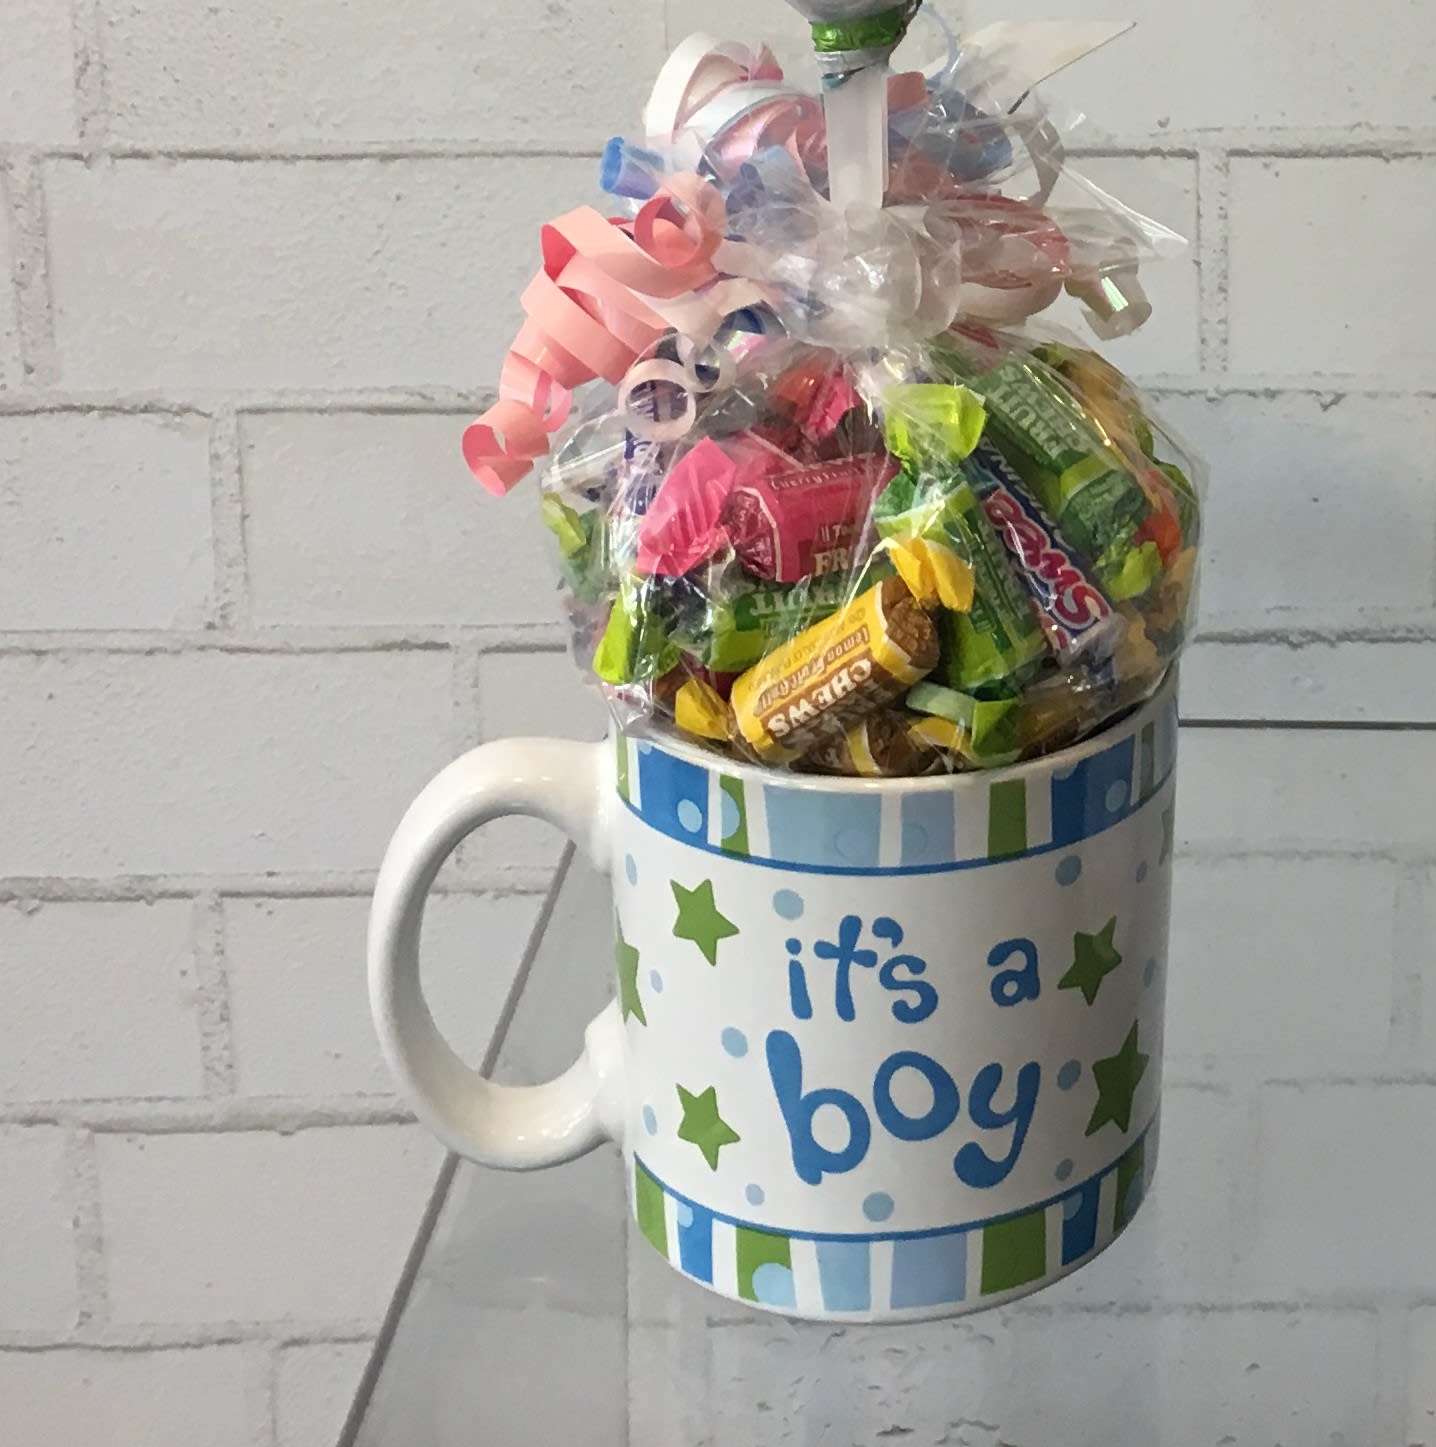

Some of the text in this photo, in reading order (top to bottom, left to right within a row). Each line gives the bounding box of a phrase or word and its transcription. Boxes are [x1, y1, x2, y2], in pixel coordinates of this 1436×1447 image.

[767, 658, 873, 739] CHEWS
[785, 915, 1042, 1024] it's a
[765, 1029, 1042, 1189] boy
